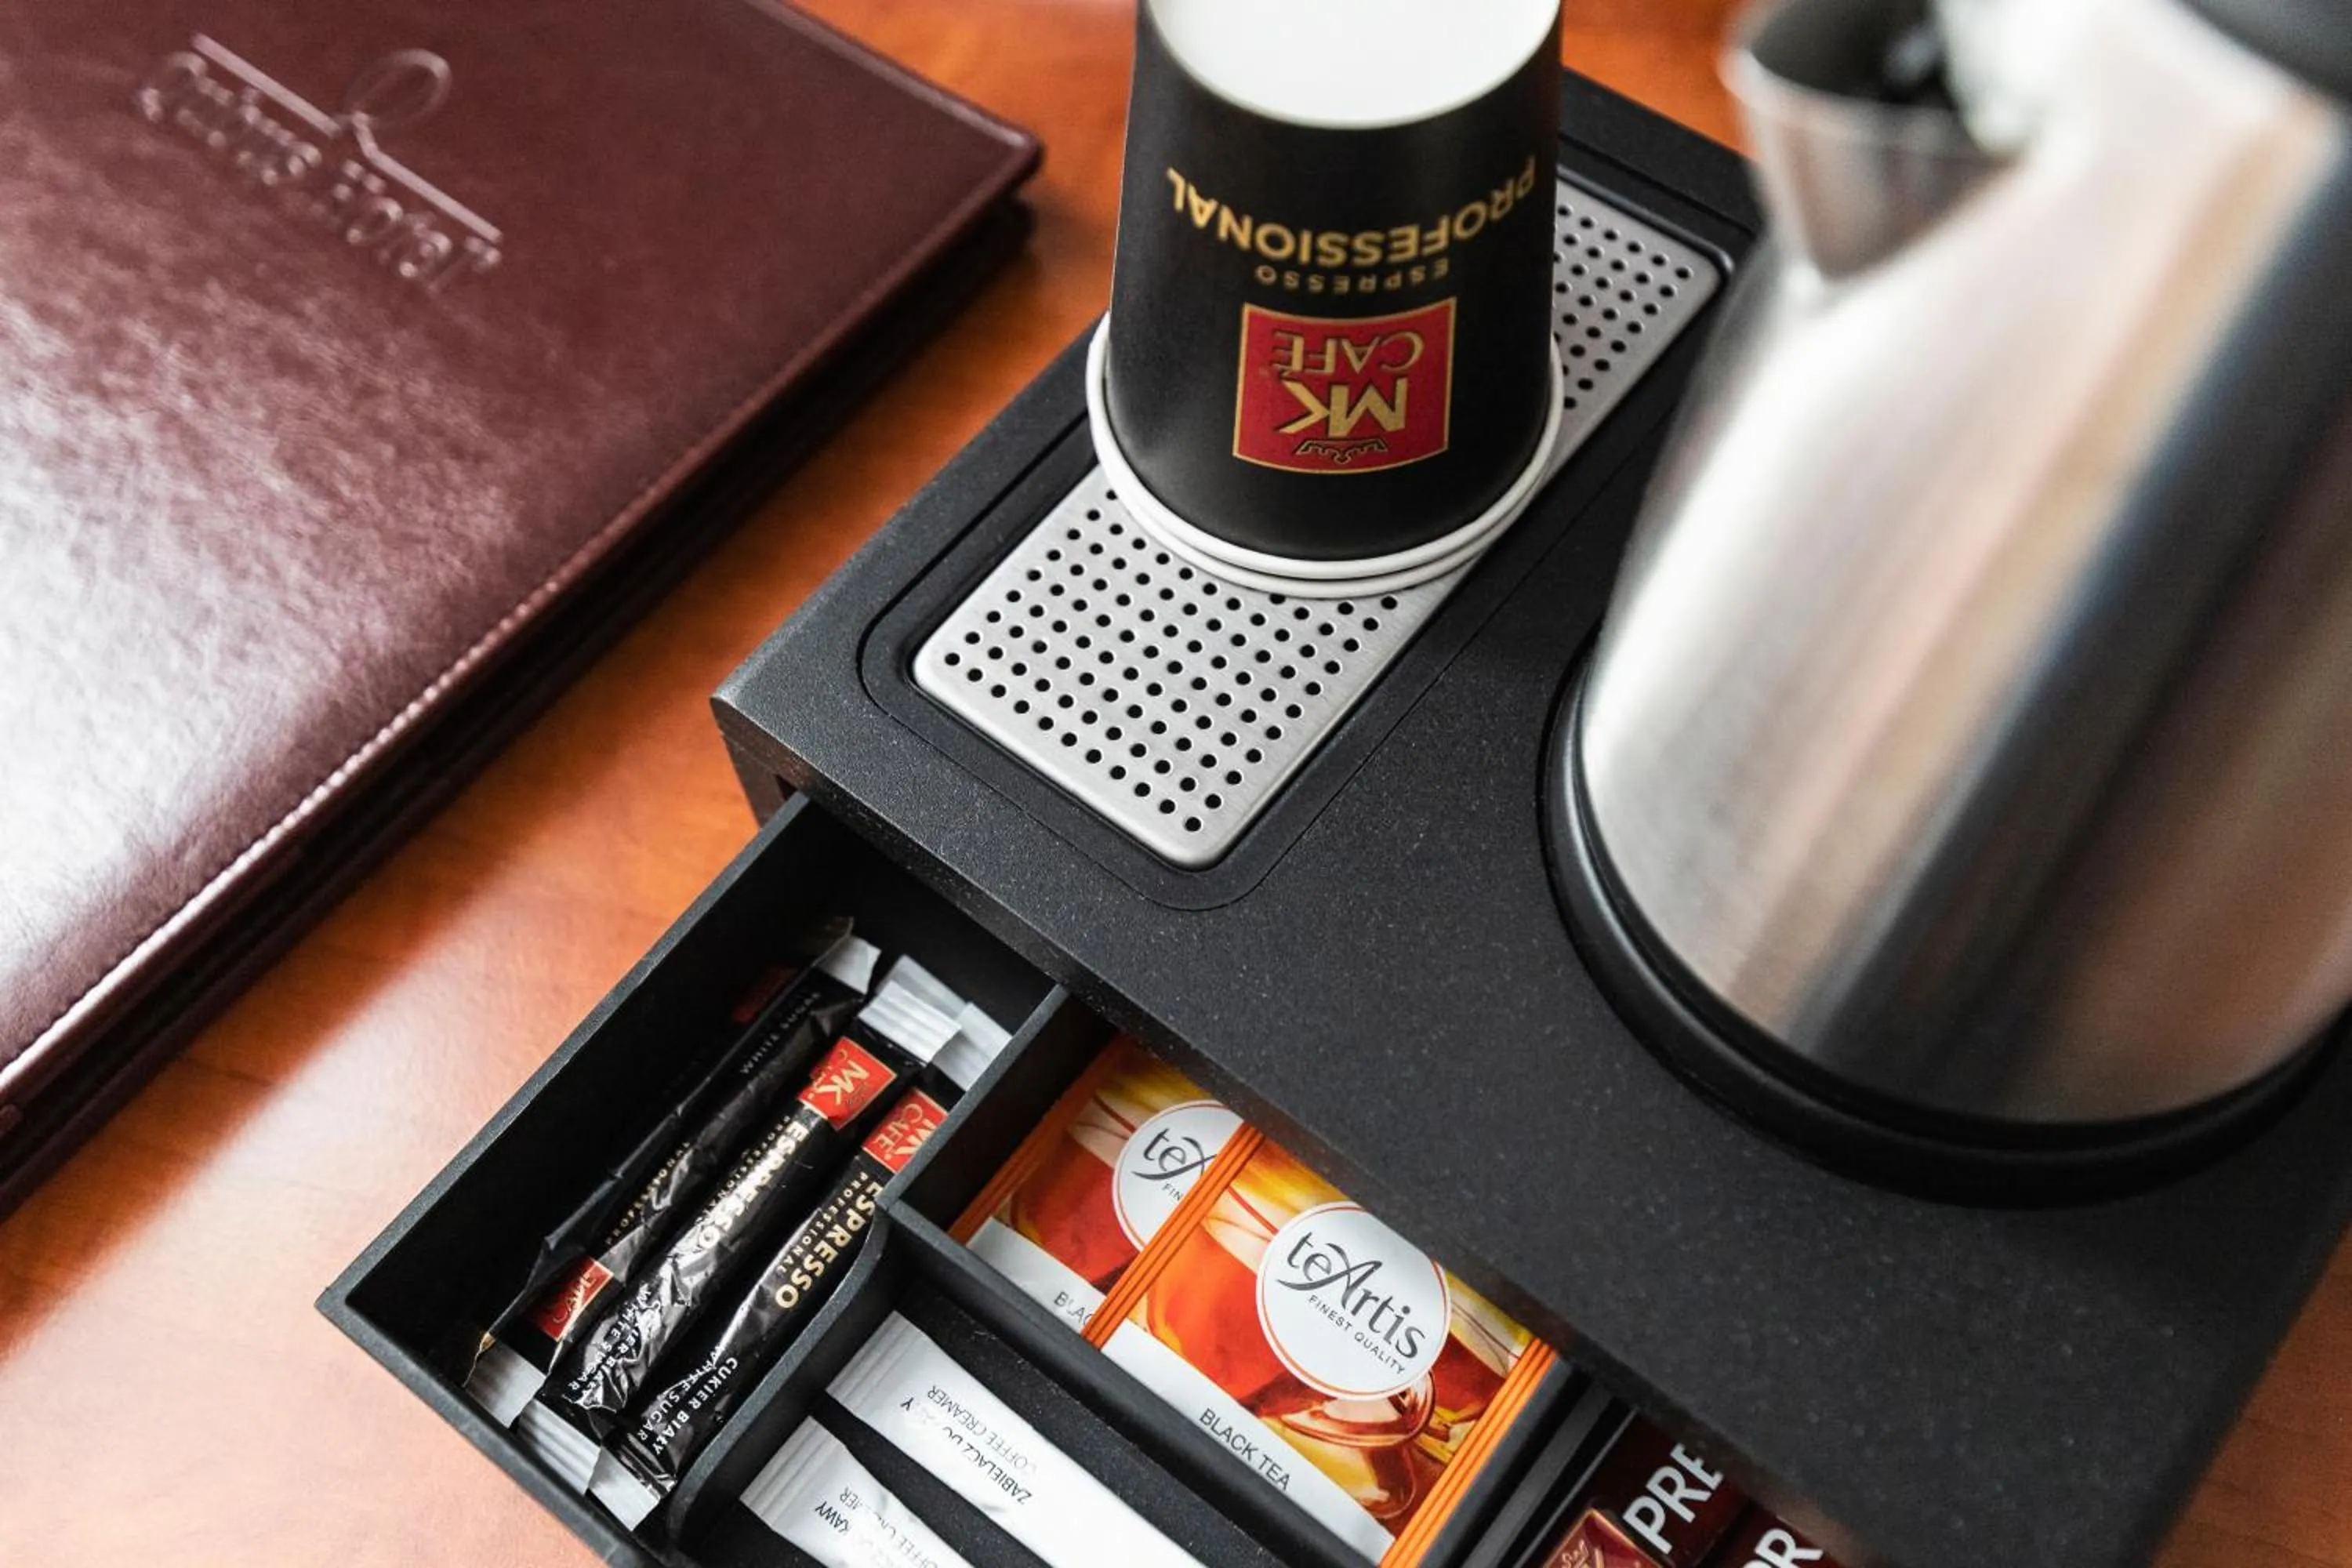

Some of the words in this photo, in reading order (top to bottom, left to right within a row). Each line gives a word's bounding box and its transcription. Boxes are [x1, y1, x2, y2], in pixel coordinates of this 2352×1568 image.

[1167, 157, 1536, 267] PROFESSIONAL
[1257, 258, 1449, 293] ESPRESSO
[1279, 376, 1408, 437] MK
[815, 1059, 870, 1105] MK
[775, 1181, 884, 1308] ESPRESSO
[777, 1171, 869, 1273] PROFESSIONAL
[1308, 1294, 1352, 1330] FINEST
[1354, 1331, 1405, 1374] QUALITY
[637, 1390, 681, 1440] SUGAR
[688, 1357, 739, 1410] CUKIER
[1200, 1408, 1258, 1461] BLACK
[1258, 1454, 1290, 1490] TEA
